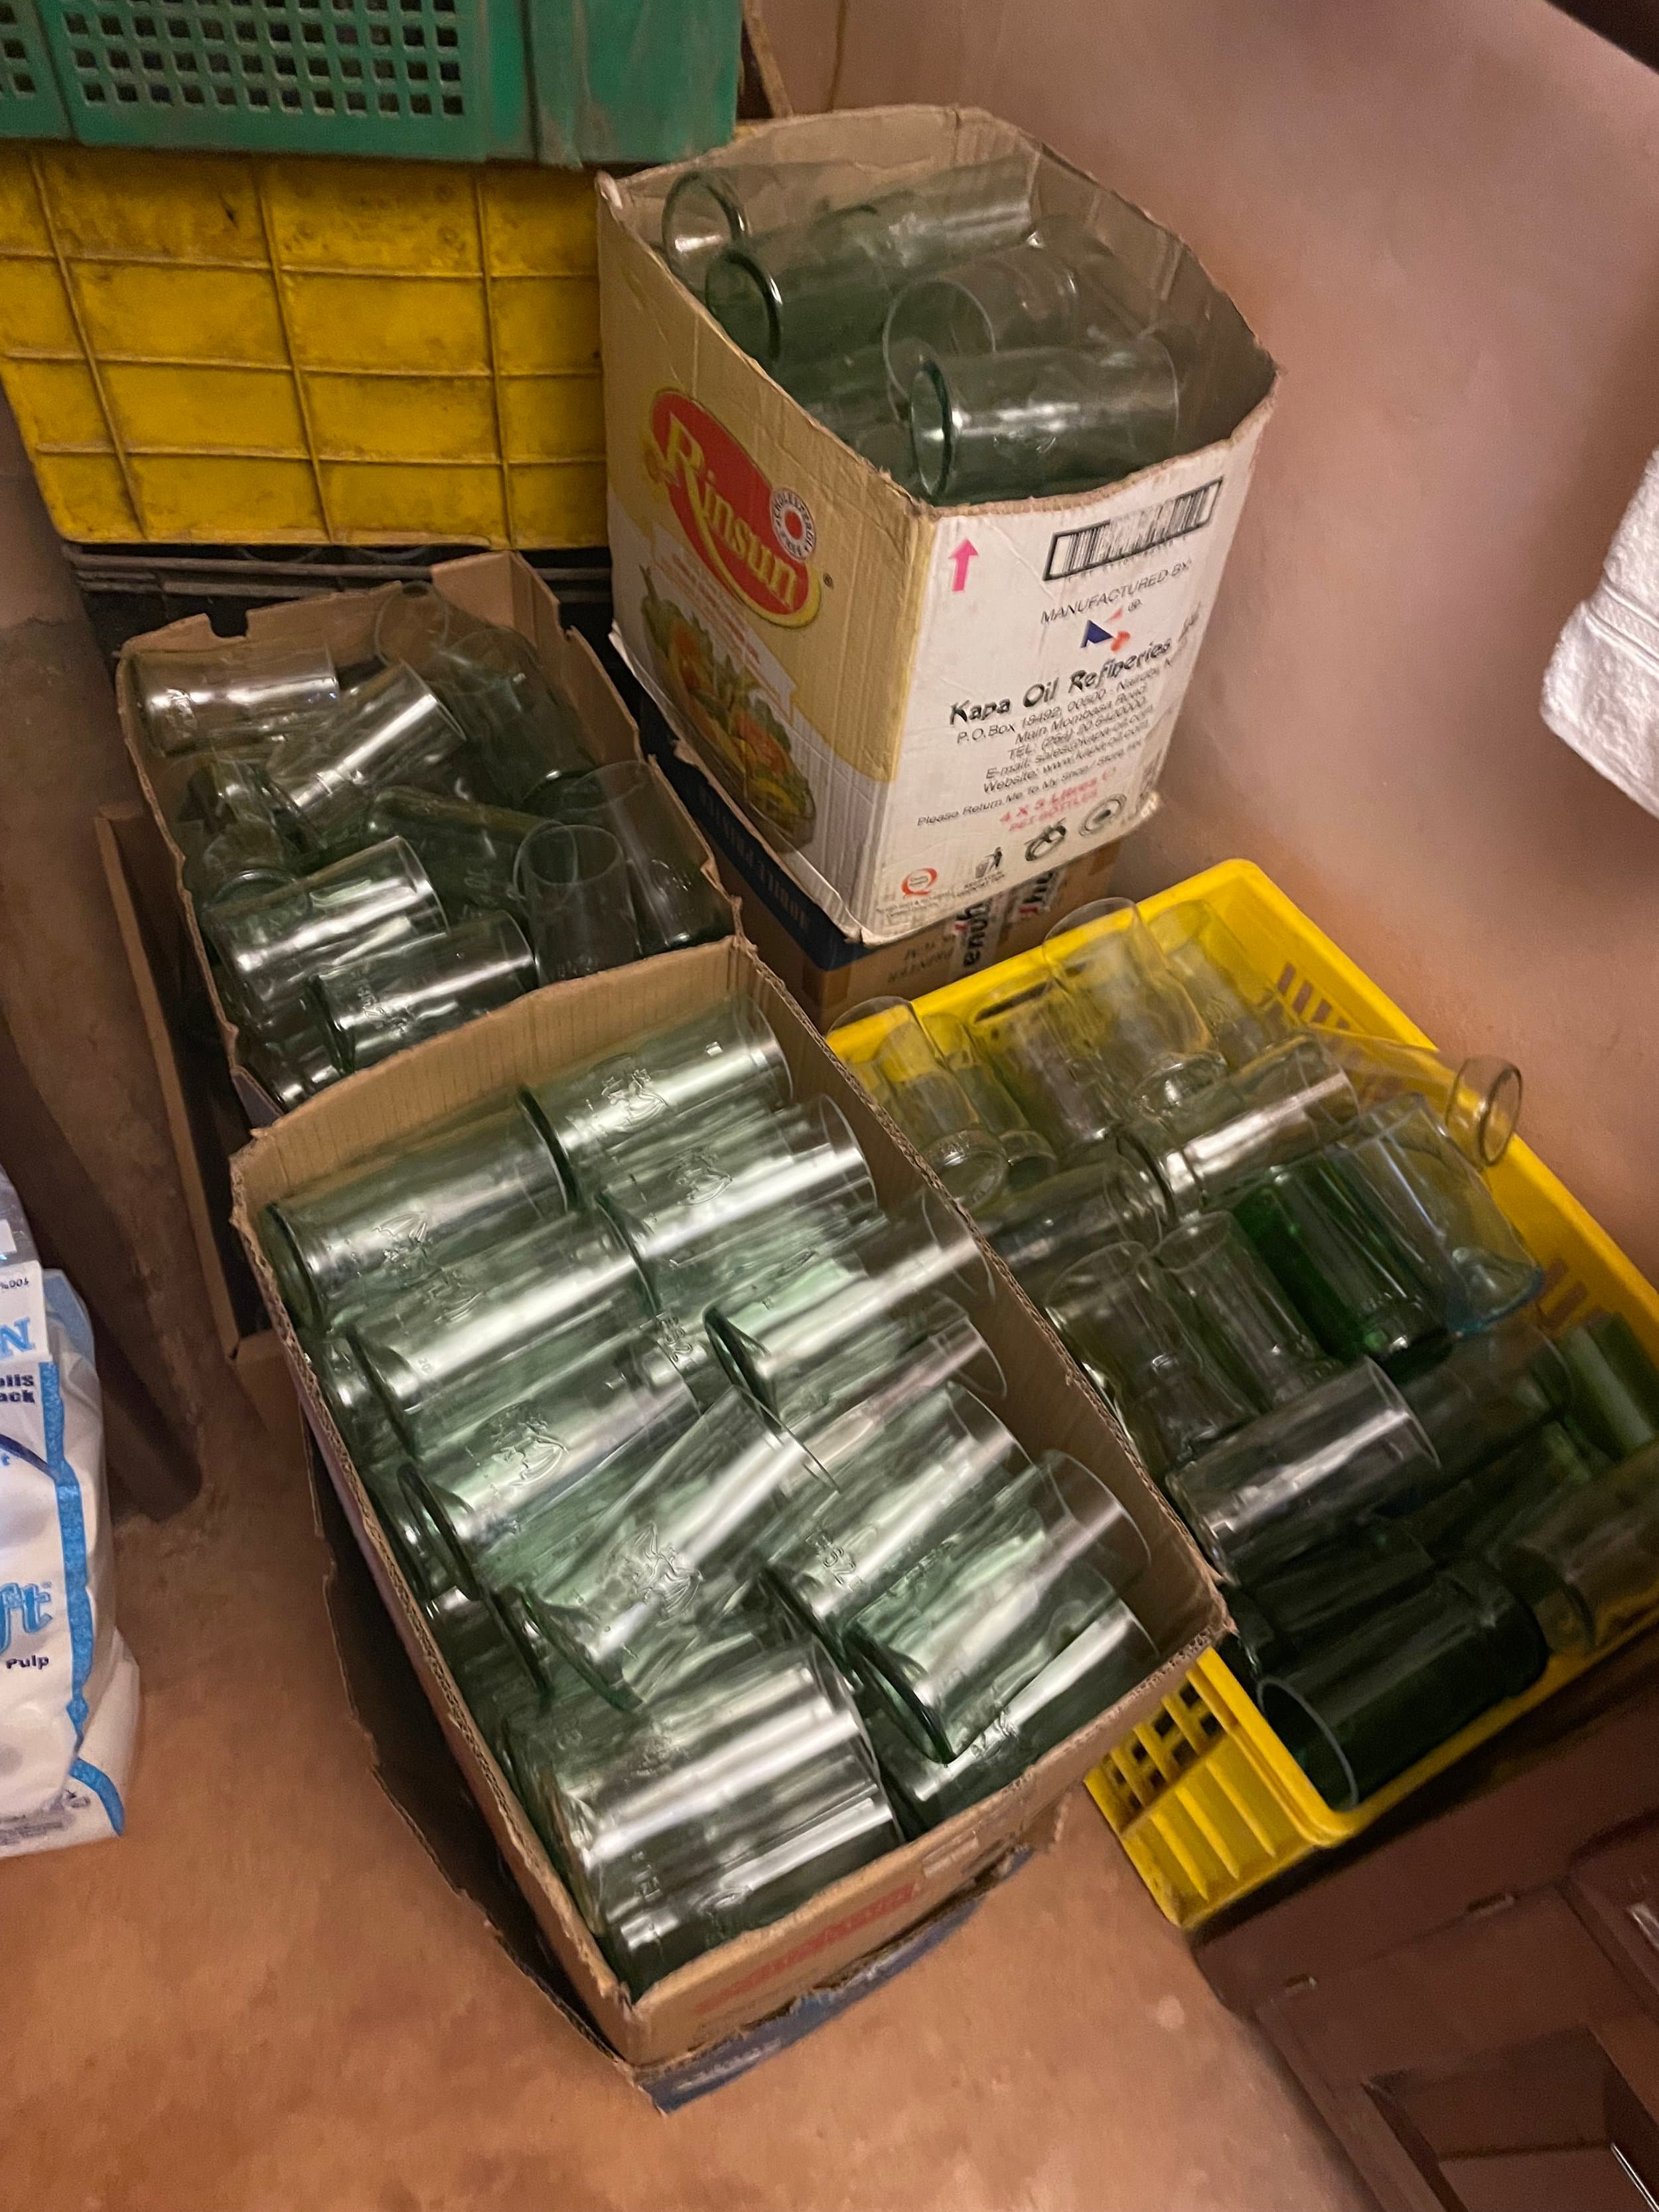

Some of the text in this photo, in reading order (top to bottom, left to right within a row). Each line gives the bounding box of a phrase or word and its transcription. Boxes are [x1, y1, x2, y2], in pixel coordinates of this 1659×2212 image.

[666, 411, 798, 610] Rinsun
[1040, 568, 1168, 625] MANUFACTURED
[949, 699, 1011, 726] Kapa
[1023, 676, 1060, 707] Oil
[1015, 726, 1047, 745] Main
[916, 810, 960, 828] Please
[1005, 790, 1023, 804] Me
